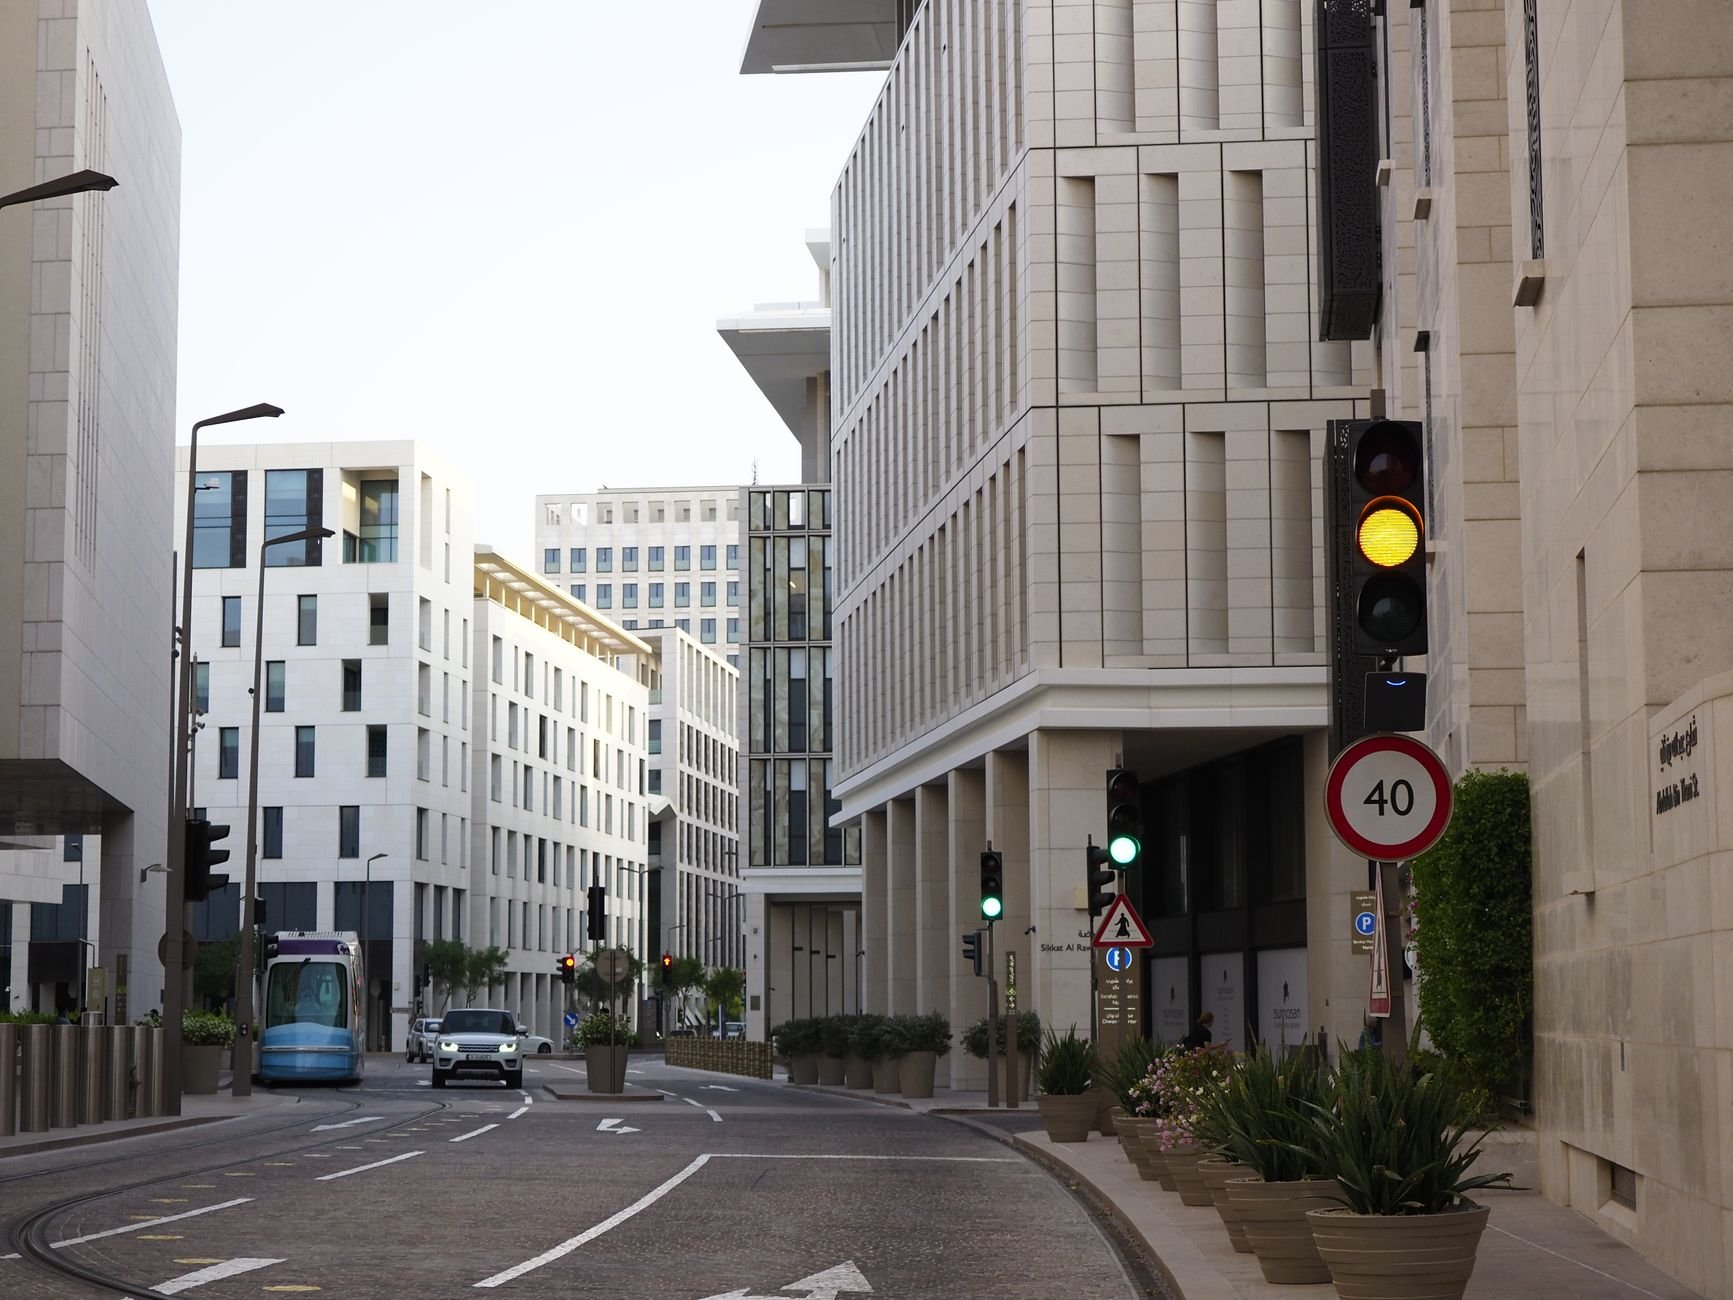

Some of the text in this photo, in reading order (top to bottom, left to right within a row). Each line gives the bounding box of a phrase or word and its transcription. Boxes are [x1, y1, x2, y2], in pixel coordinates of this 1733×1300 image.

[1363, 779, 1414, 816] 40
[1362, 917, 1371, 930] P
[1040, 943, 1063, 952] Sikkat
[1066, 943, 1075, 952] Al
